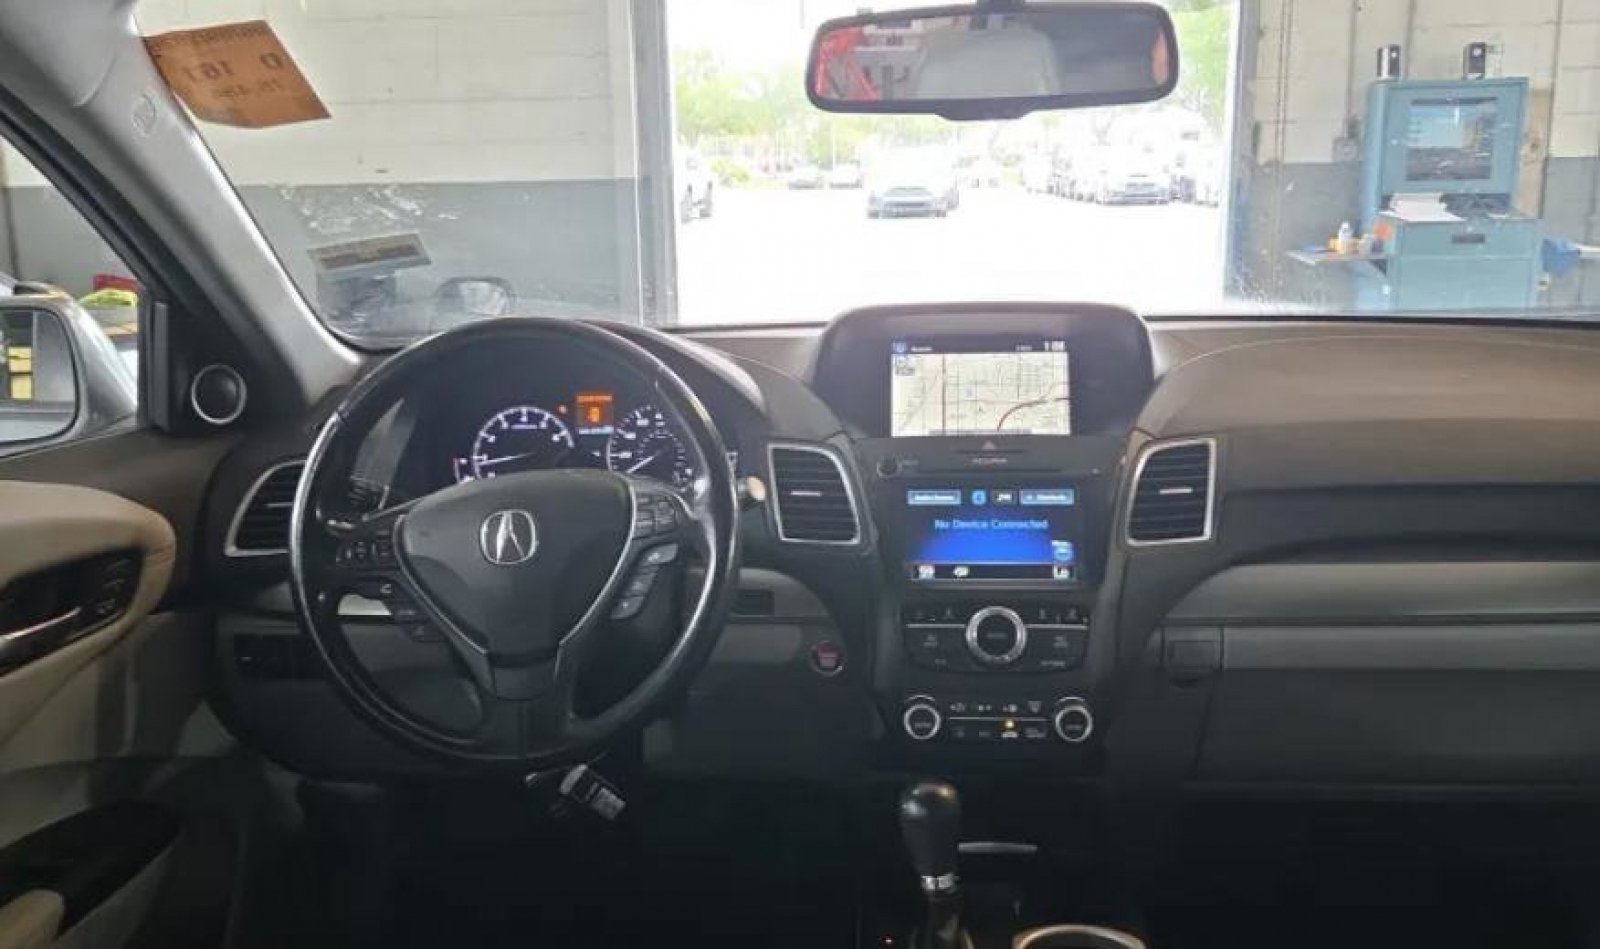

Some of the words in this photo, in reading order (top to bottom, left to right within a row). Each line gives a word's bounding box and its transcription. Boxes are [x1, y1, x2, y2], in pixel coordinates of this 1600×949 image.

[934, 519, 950, 530] No
[953, 519, 988, 530] Device
[991, 519, 1049, 530] Connected
